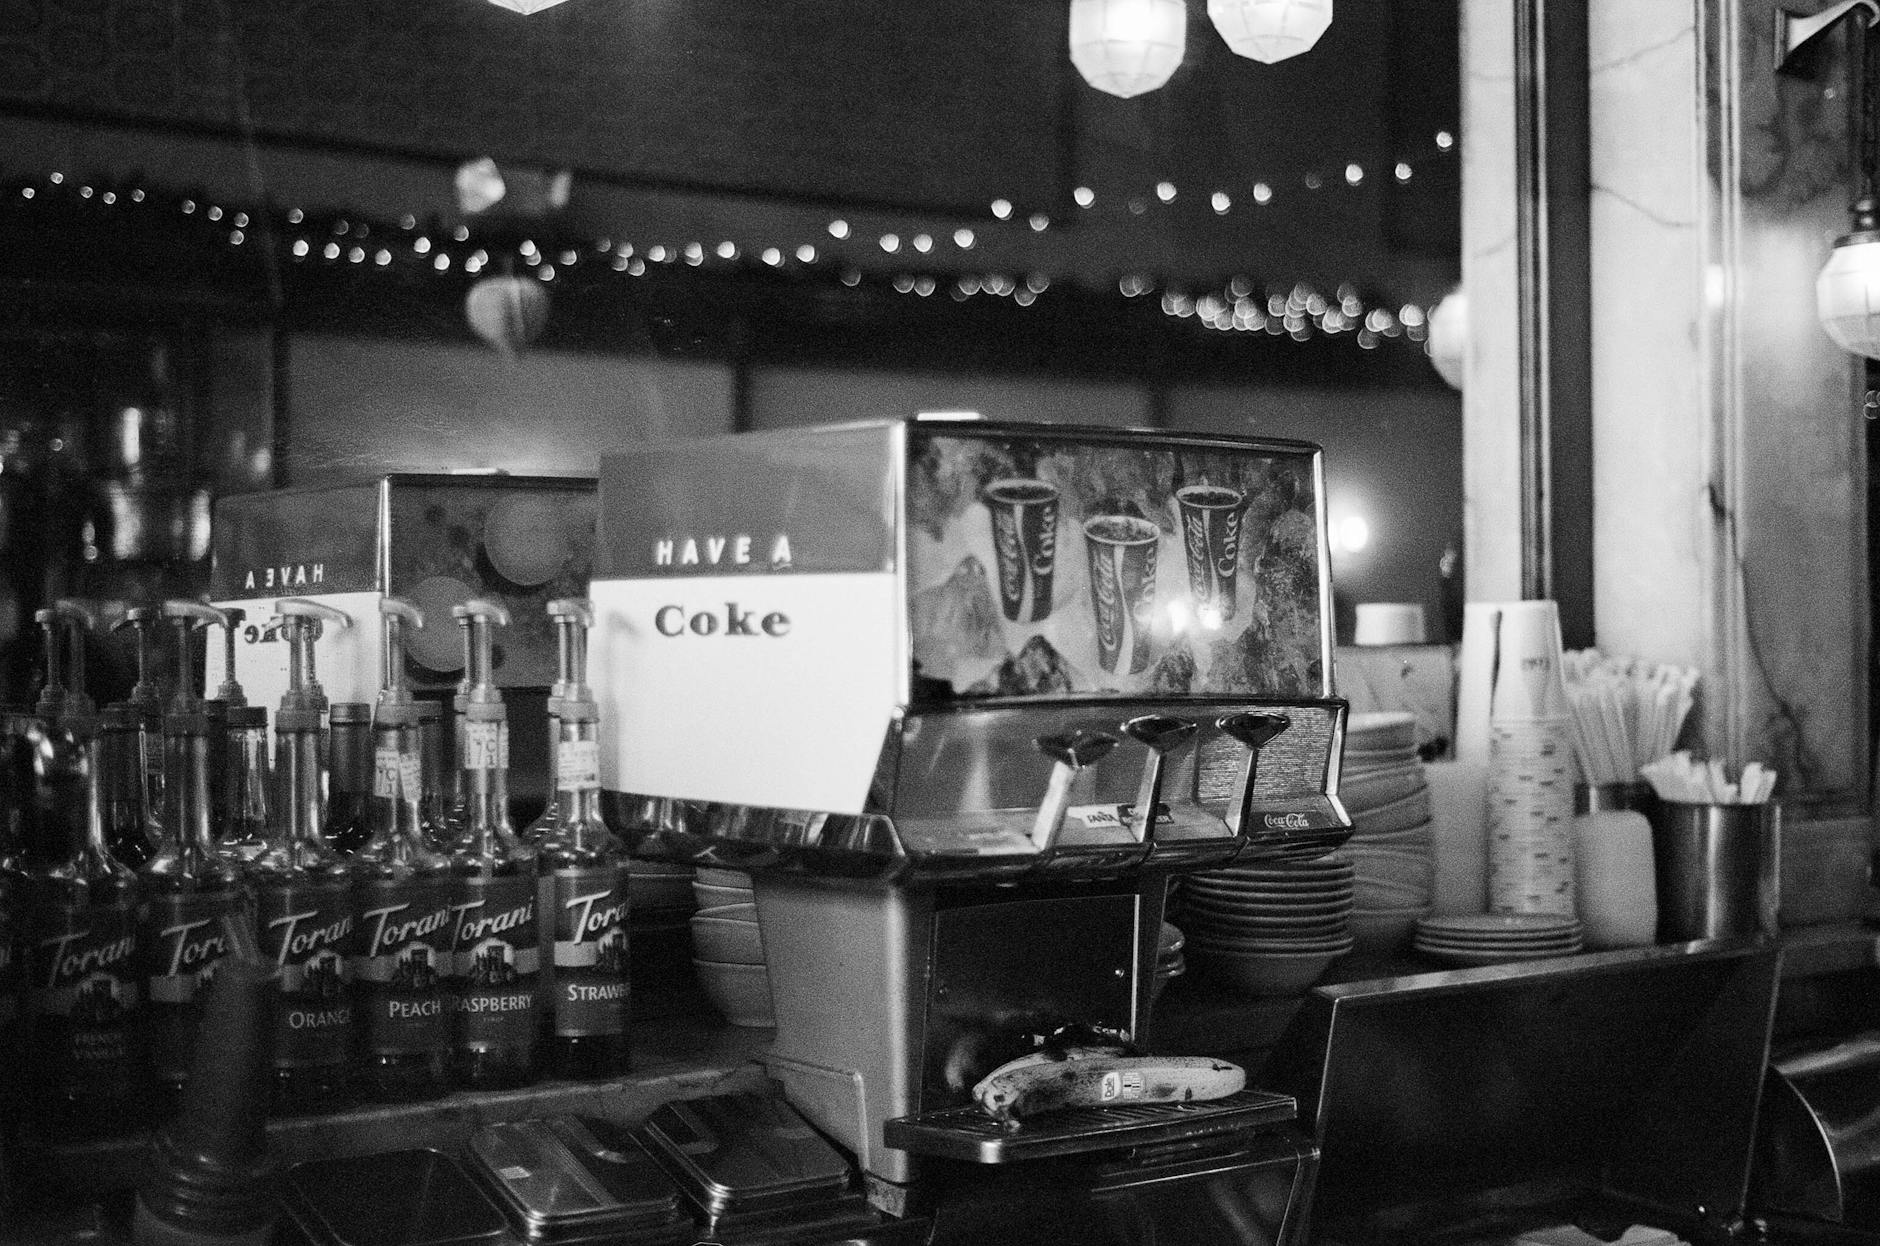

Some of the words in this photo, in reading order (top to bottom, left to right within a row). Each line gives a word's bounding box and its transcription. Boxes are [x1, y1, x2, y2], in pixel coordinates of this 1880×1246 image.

[656, 535, 751, 566] HAVE
[772, 534, 793, 568] A
[1217, 511, 1238, 578] Coke
[655, 602, 792, 638] Coke
[1264, 813, 1309, 829] Coca-Cola
[267, 910, 353, 965] Toran
[451, 895, 534, 952] Torani
[565, 889, 631, 946] Tora
[388, 999, 442, 1019] PEACH
